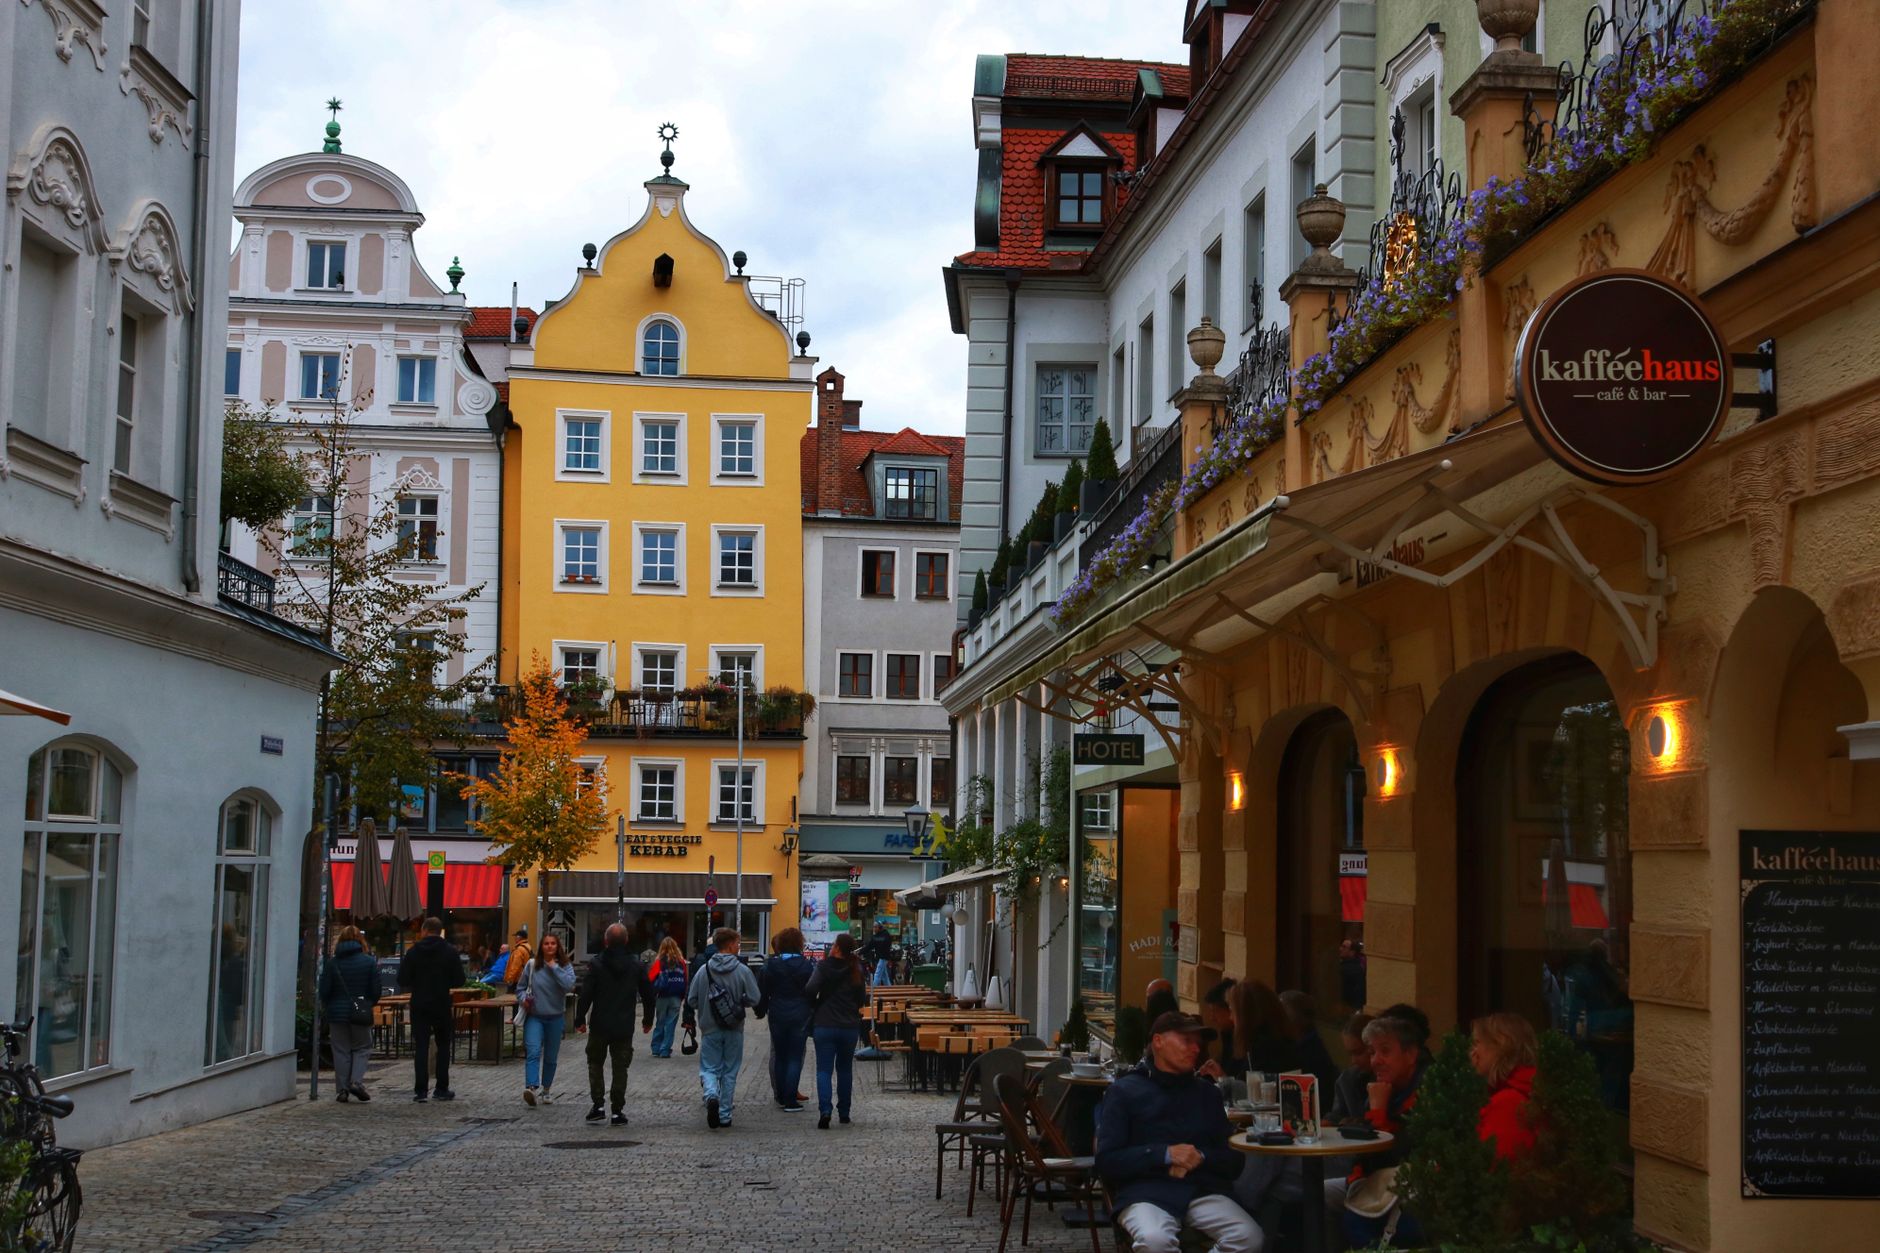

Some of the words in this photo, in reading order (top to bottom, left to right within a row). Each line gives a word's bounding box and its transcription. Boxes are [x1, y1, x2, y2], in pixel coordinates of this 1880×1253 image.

[1539, 346, 1721, 382] kafféehaus
[1596, 386, 1624, 402] café
[1628, 388, 1639, 402] &
[1643, 387, 1667, 402] bar
[1077, 741, 1141, 759] HOTEL
[658, 835, 702, 844] VEGGIE
[630, 845, 688, 856] KEBAB
[1129, 936, 1160, 952] HADI
